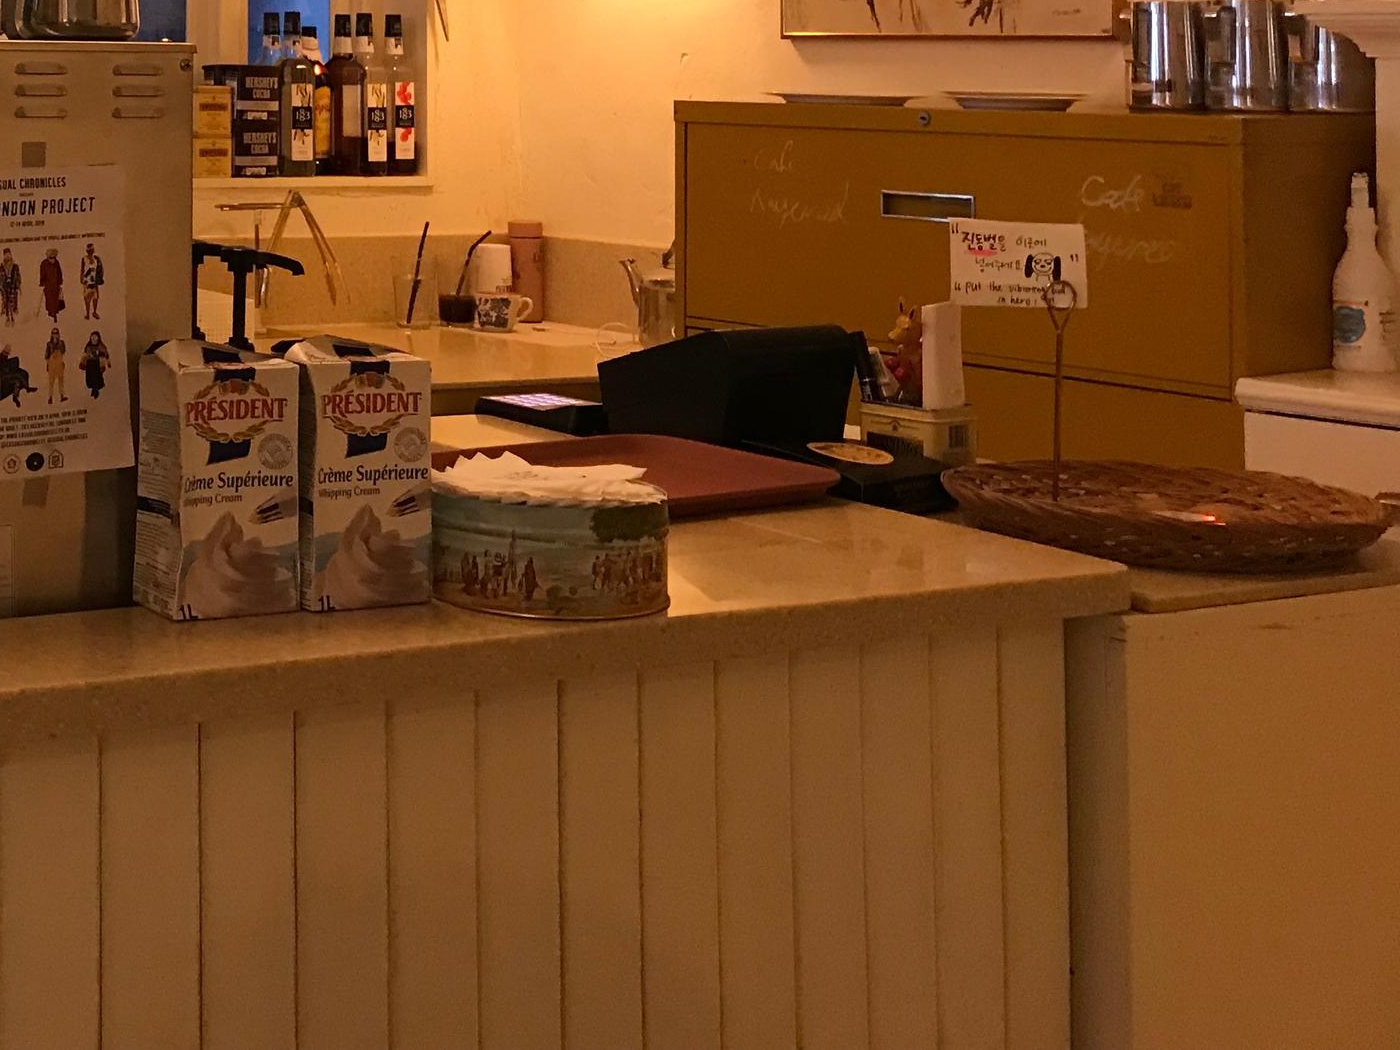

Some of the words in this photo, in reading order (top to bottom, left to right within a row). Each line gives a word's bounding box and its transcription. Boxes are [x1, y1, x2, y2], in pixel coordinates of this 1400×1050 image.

[19, 176, 67, 189] CHRONICLES
[41, 196, 96, 215] PROJECT
[185, 397, 288, 425] PRÉSIDENT
[320, 390, 422, 418] PRÉSIDENT
[217, 470, 294, 493] Supérieure
[318, 466, 353, 484] Crème
[356, 463, 429, 486] Supérieure
[179, 603, 198, 620] 1L
[317, 595, 336, 612] 1L
